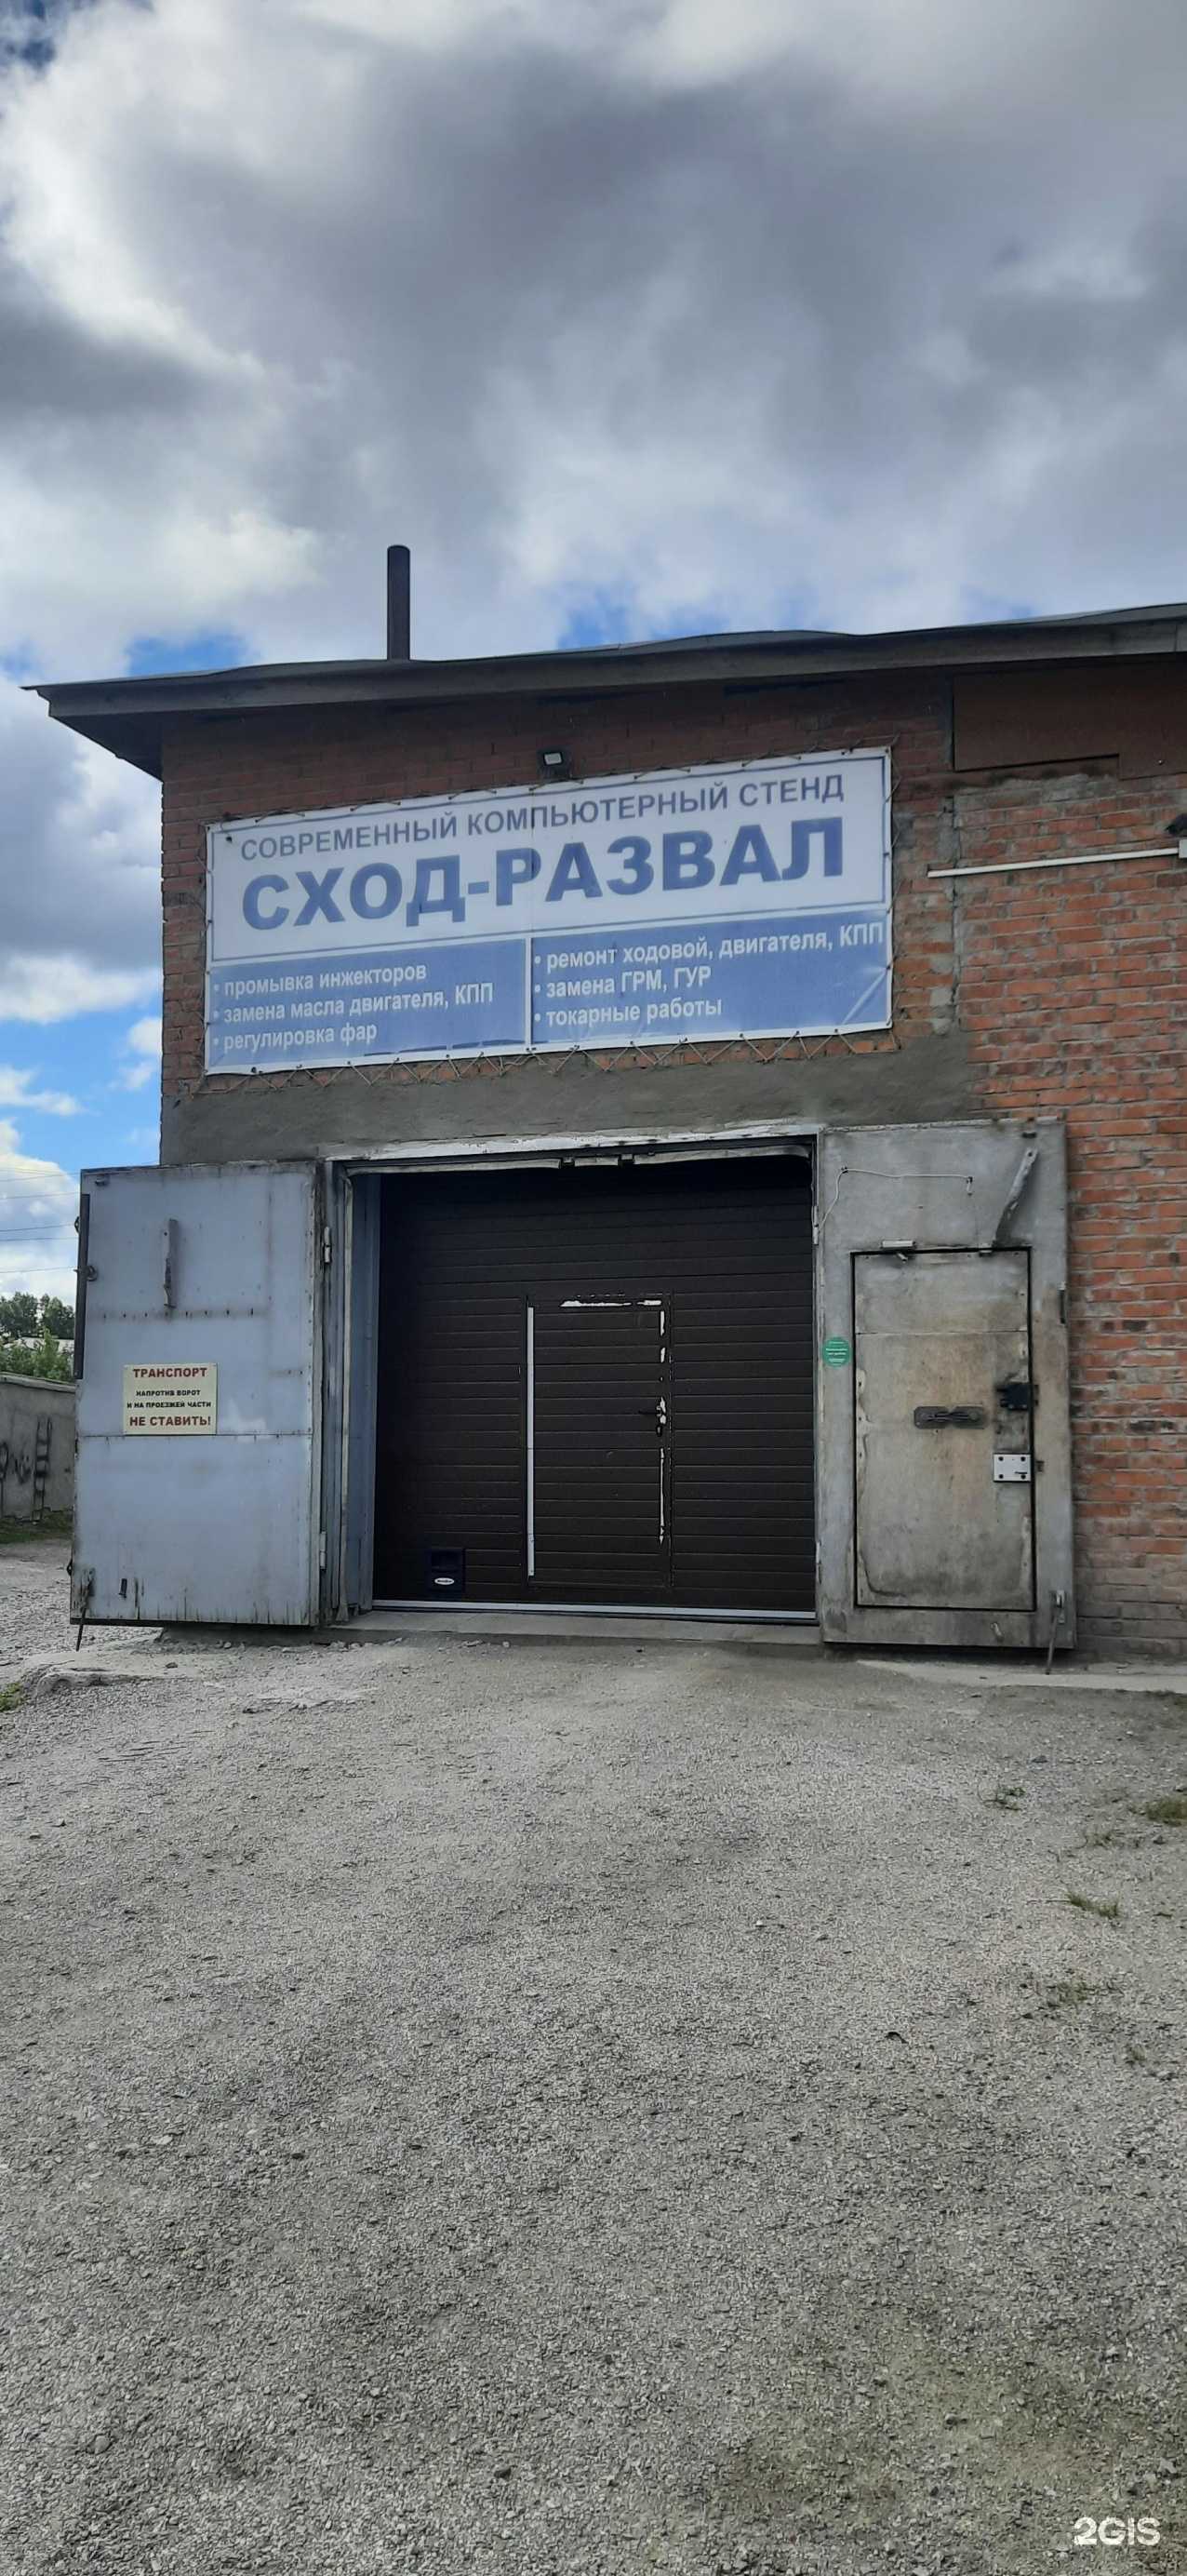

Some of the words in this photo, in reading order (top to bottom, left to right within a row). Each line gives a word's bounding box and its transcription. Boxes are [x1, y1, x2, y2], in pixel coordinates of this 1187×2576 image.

[241, 812, 457, 861] СОВРЕМЕННЫЙ
[468, 782, 727, 836] КОМПЬЮТЕРНЫЙ
[739, 774, 844, 807] СТЕНД
[242, 817, 843, 930] СХОД-РАЗВАЛ
[547, 949, 617, 973] ремонт
[623, 936, 714, 963] ходовой,
[718, 931, 834, 957] двигателя,
[840, 922, 883, 946] КПП
[224, 975, 313, 999] промывка
[320, 964, 427, 987] инжекторов
[546, 977, 614, 998] замена
[621, 969, 668, 993] ГРМ,
[674, 965, 712, 988] ГУР
[224, 1003, 285, 1023] замена
[290, 1000, 344, 1019] масла
[349, 992, 448, 1014] двигателя,
[455, 983, 493, 1004] КПП
[546, 1003, 640, 1028] токарные
[647, 997, 722, 1020] работы
[224, 1026, 335, 1053] регулировка
[340, 1023, 377, 1046] фар
[133, 1368, 207, 1377] ТРАНСПОРТ
[129, 1416, 146, 1426] НЕ
[150, 1416, 211, 1426] СТАВИТЬ!
